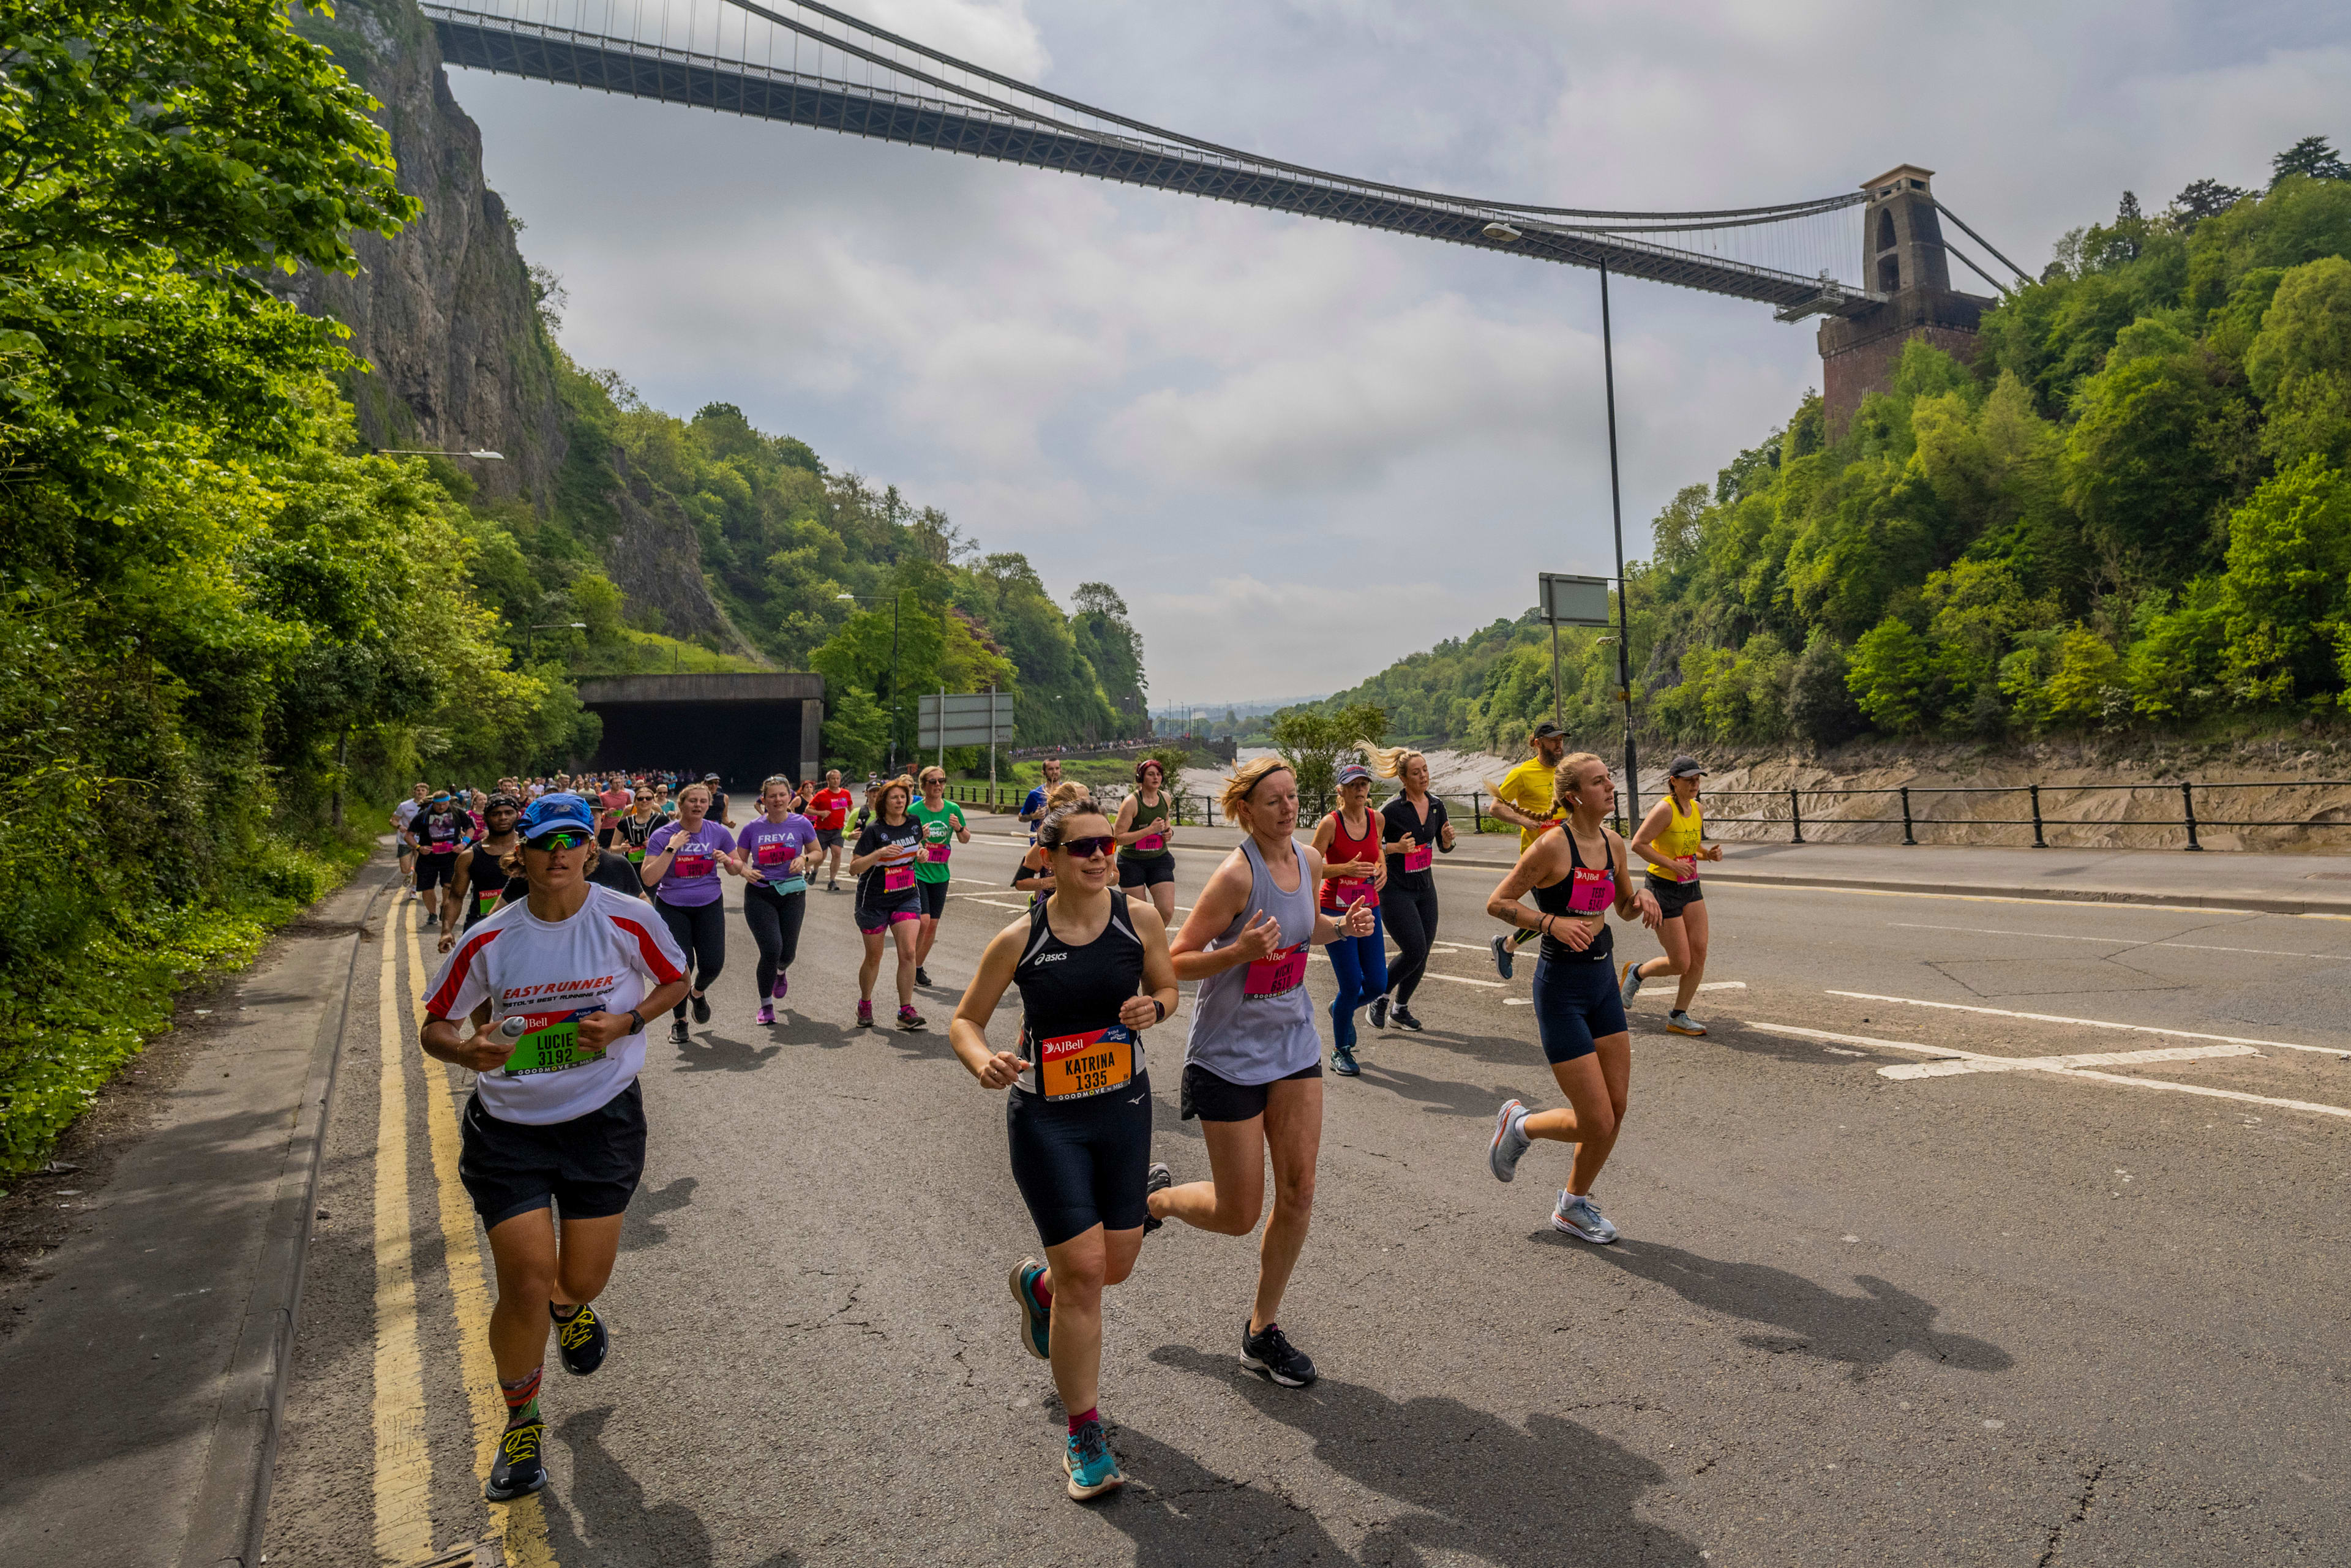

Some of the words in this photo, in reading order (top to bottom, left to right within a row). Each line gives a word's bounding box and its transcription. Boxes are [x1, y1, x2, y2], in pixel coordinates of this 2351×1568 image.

[758, 833, 795, 843] FREYA
[891, 836, 917, 847] SARAH
[680, 842, 710, 852] IZZY
[1581, 873, 1600, 882] AJBell
[1592, 887, 1606, 899] TESS
[1273, 962, 1294, 980] NICKI
[1254, 989, 1288, 999] GOODMOVE
[525, 1018, 548, 1030] JBell
[537, 1032, 574, 1051] LUCIE
[1052, 1038, 1084, 1054] AJBell
[538, 1048, 573, 1066] 3192
[518, 1063, 569, 1075] GOODMOVE
[1065, 1051, 1116, 1076] KATRINA
[1076, 1070, 1108, 1091] 1335
[1059, 1087, 1105, 1101] GOODMOVE
[1113, 1082, 1123, 1090] M&S
